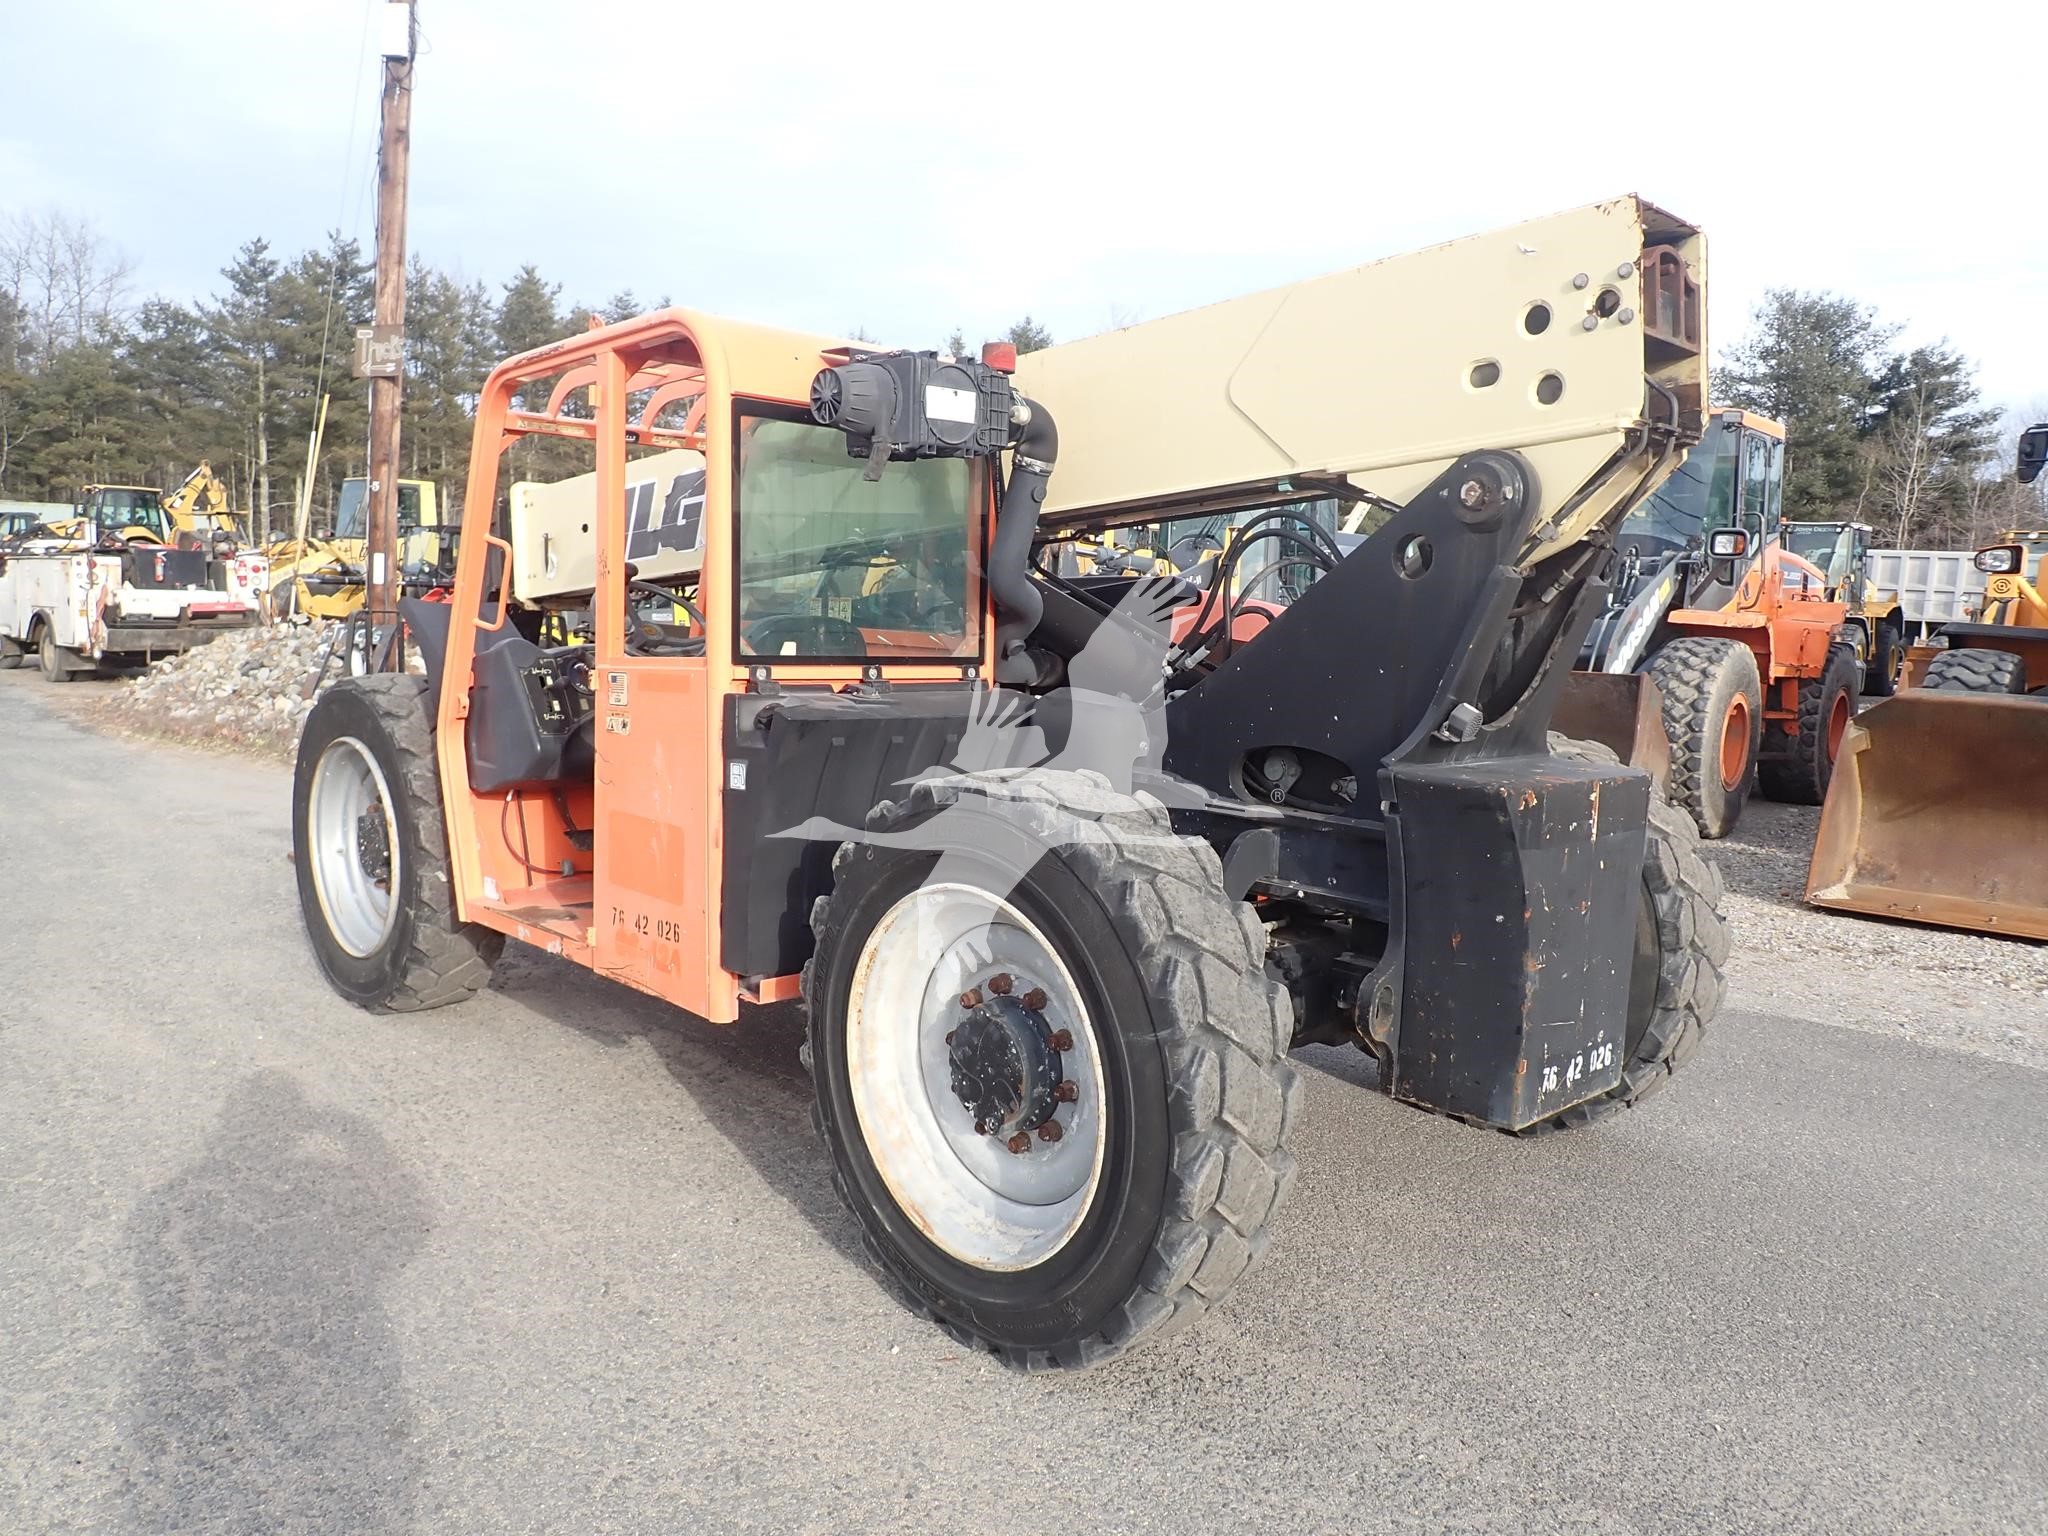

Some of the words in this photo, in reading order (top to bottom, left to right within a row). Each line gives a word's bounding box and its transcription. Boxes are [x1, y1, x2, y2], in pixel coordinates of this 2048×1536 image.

[625, 469, 706, 561] LG
[635, 914, 648, 935] 42
[657, 919, 680, 943] 026
[1567, 1055, 1583, 1086] 42
[1590, 1042, 1612, 1072] 026
